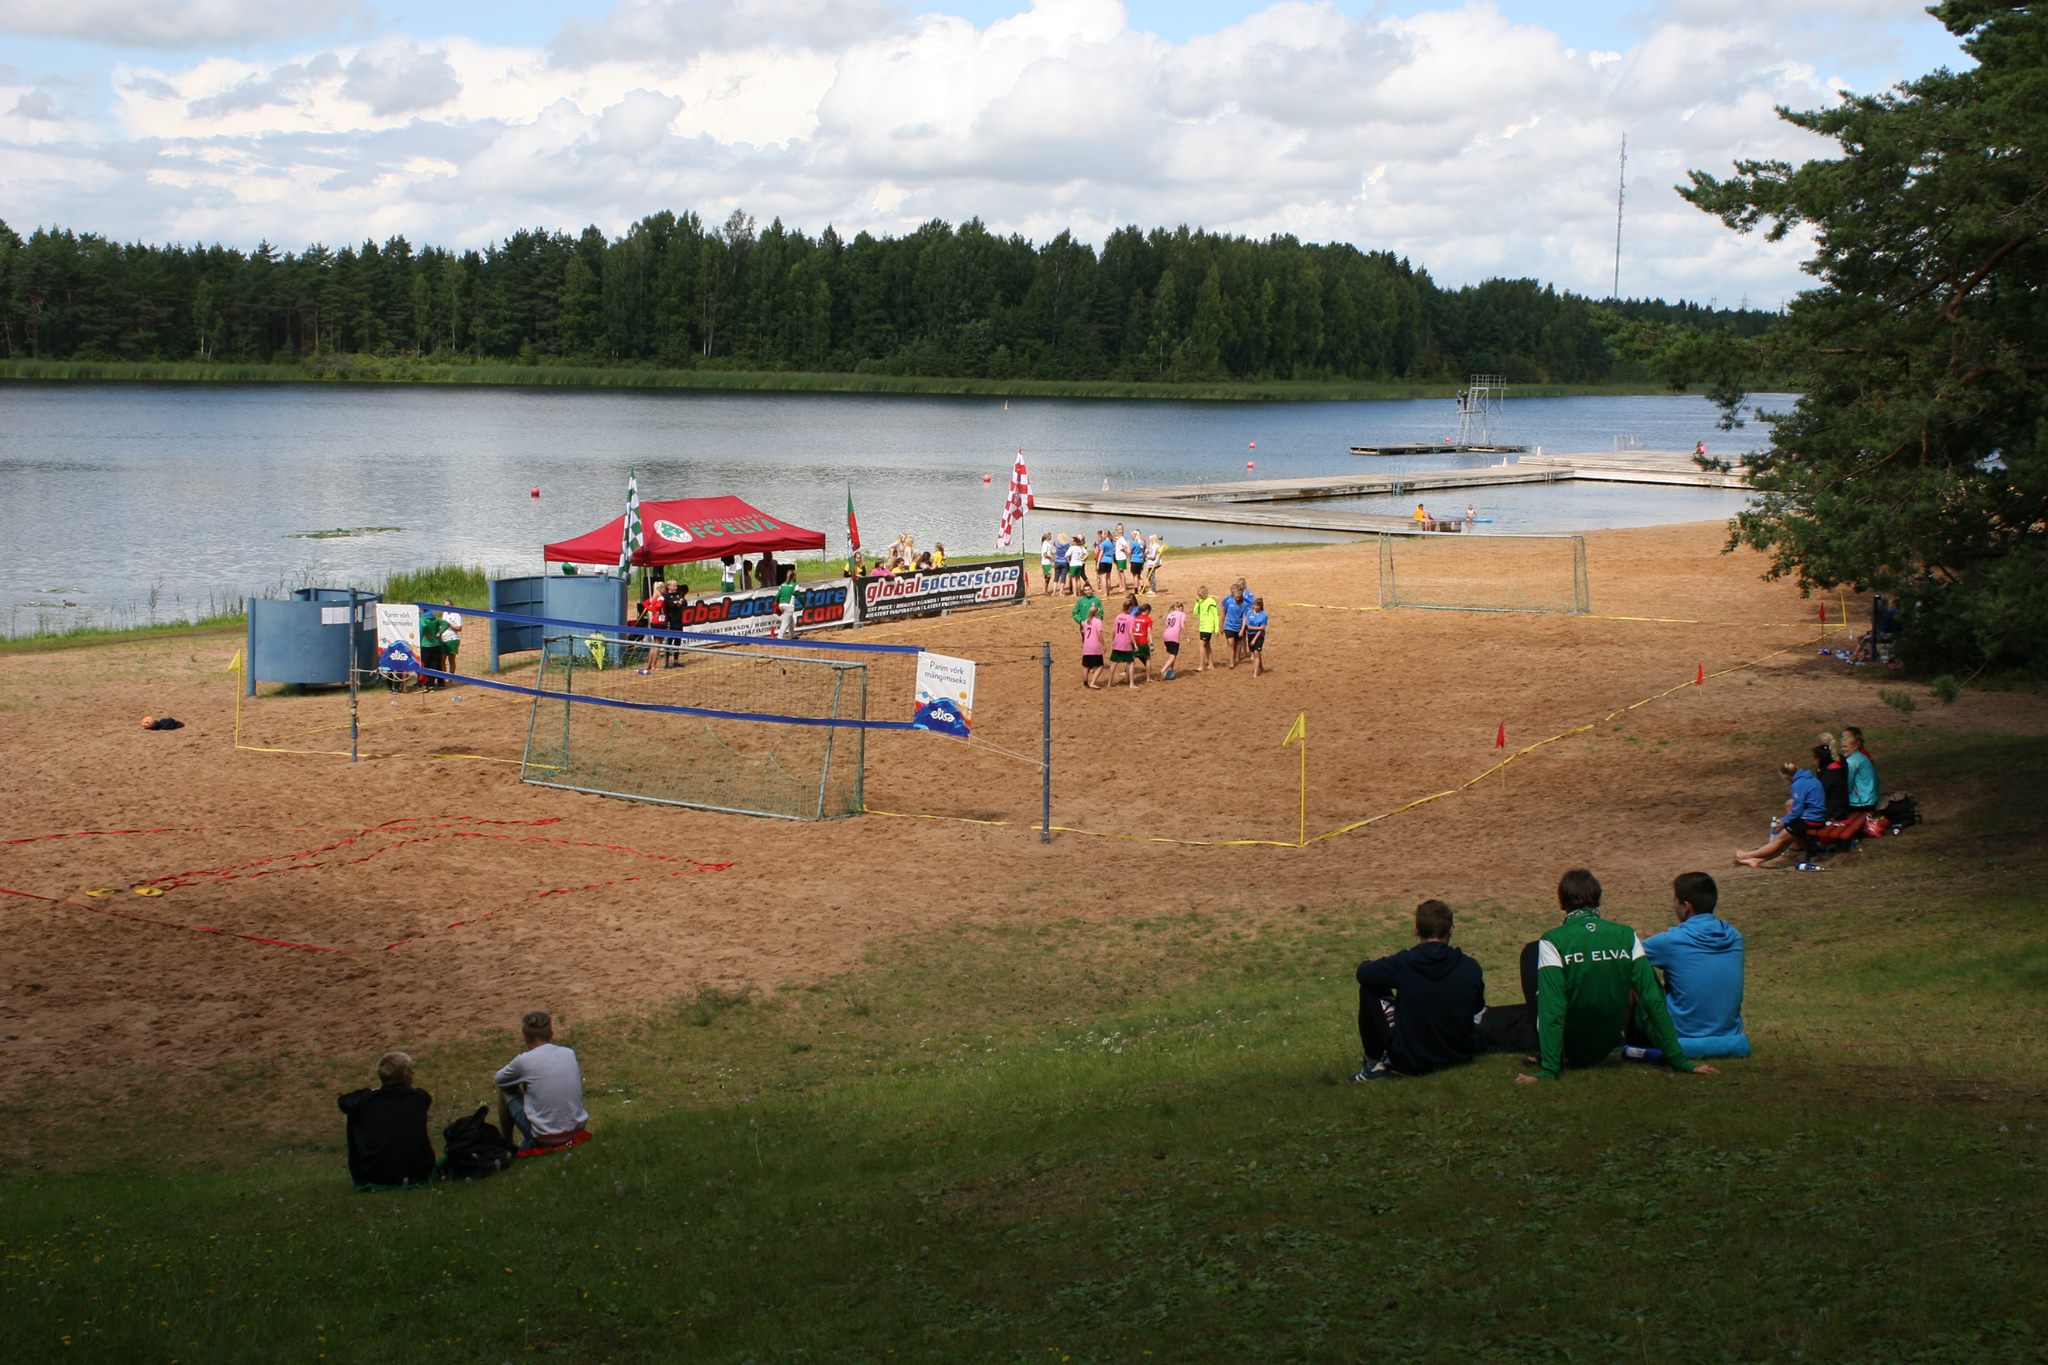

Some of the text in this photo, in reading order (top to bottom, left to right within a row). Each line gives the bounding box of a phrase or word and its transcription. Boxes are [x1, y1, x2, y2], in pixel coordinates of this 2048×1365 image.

[690, 519, 781, 538] FC ELVA
[865, 566, 1019, 604] globalsoccerstore
[929, 660, 964, 675] Parim võrk
[924, 671, 967, 685] mängimiseks
[930, 707, 955, 723] elisa
[1564, 949, 1631, 965] FC ELVA
